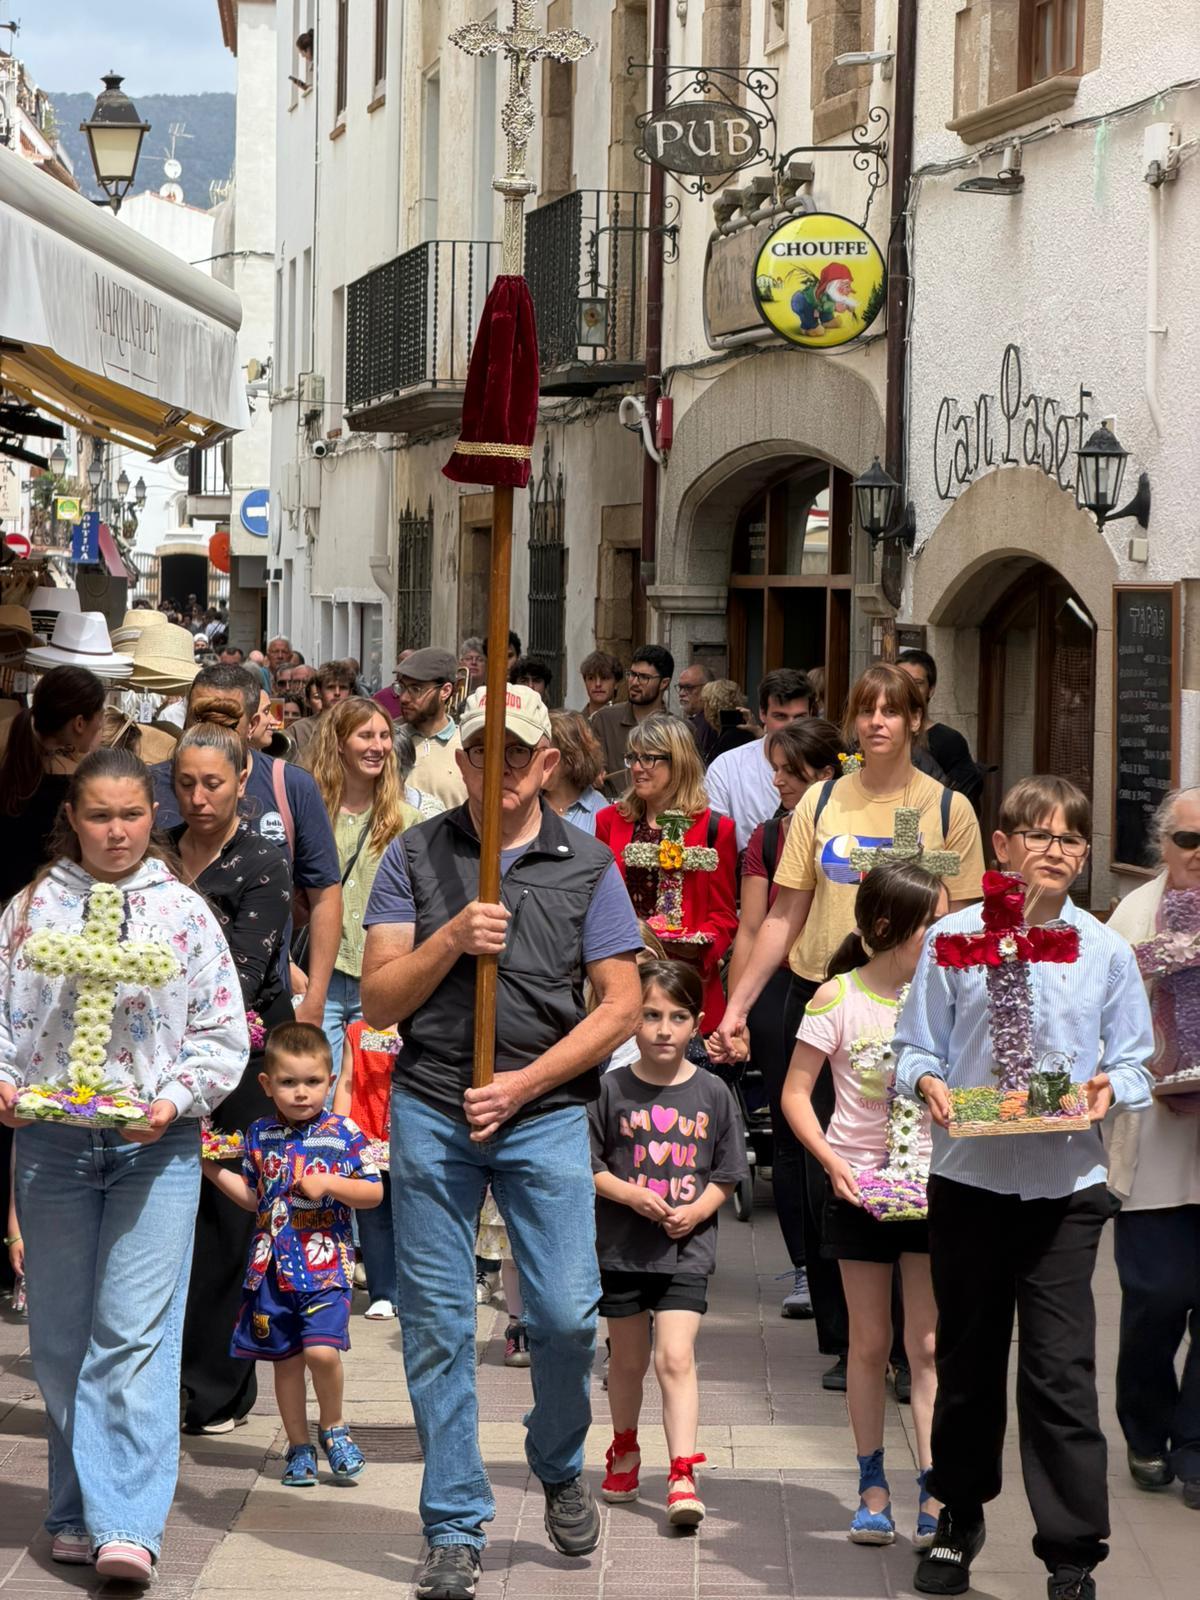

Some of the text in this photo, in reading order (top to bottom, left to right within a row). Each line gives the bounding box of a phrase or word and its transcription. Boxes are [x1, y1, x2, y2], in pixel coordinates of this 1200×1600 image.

[651, 118, 753, 158] PUB
[771, 241, 868, 256] CHOUFFE
[80, 514, 91, 560] OPTICA
